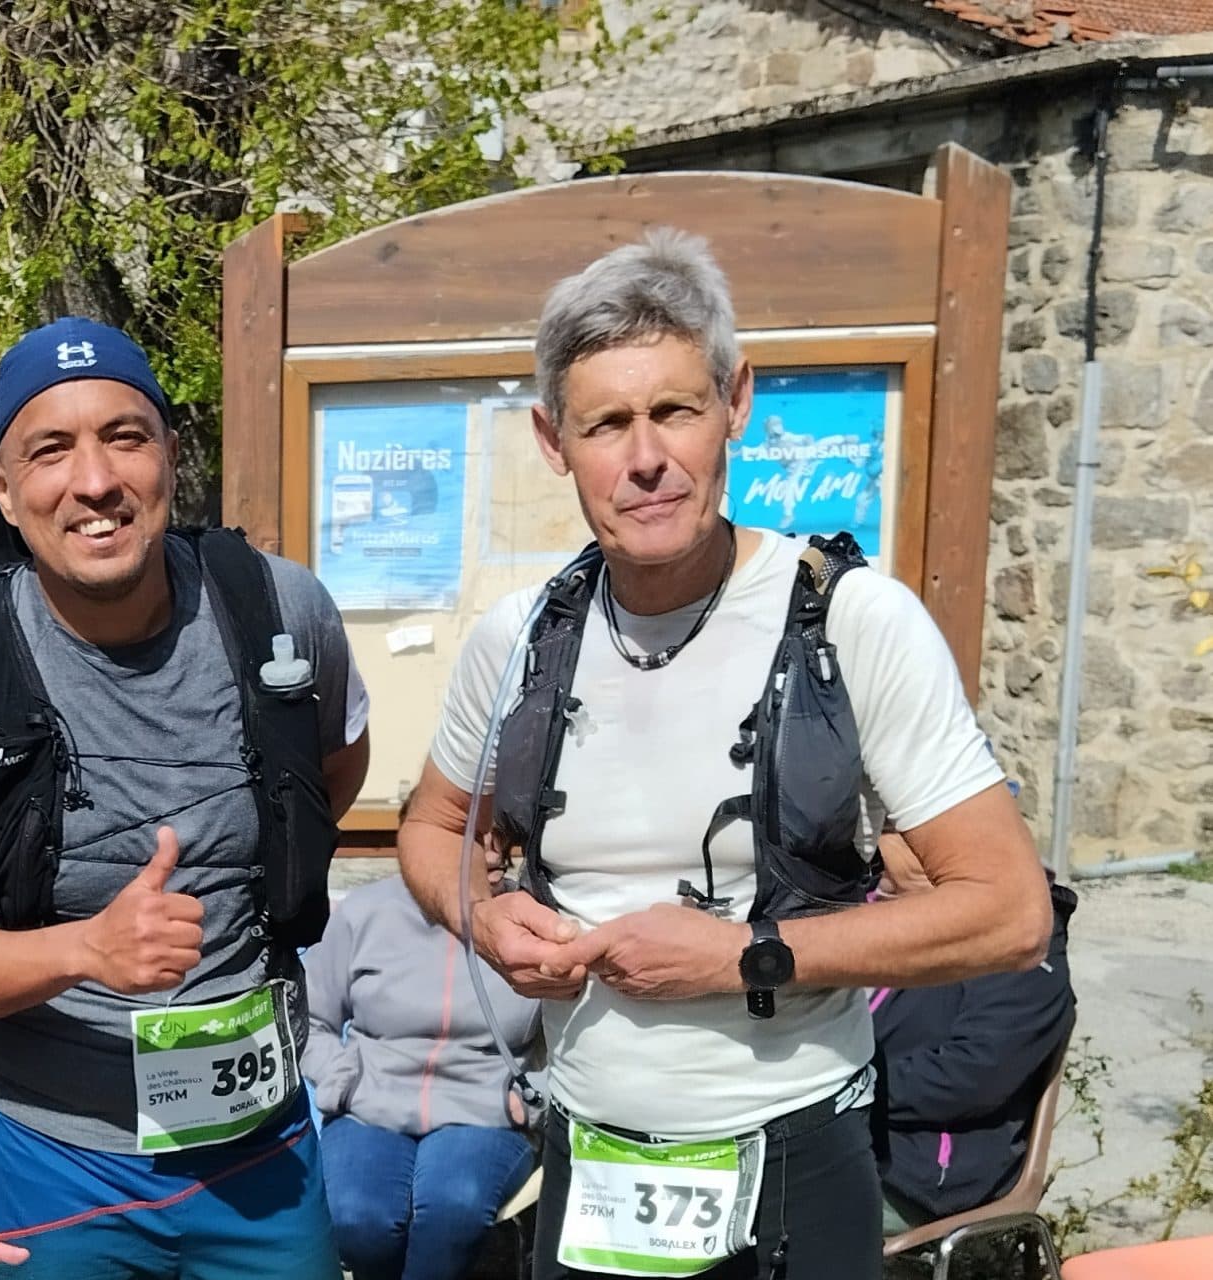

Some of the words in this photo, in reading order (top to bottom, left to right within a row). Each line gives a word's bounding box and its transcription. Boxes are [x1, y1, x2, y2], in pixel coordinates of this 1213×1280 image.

[338, 440, 451, 471] Nozières
[742, 443, 871, 462] L'ADVERSAIRE
[744, 473, 811, 507] MON
[810, 471, 863, 505] AMI
[228, 1001, 268, 1030] RAIDLIGHT
[211, 1043, 276, 1097] 395
[149, 1089, 187, 1106] 57KM
[580, 1203, 615, 1219] 57KM
[634, 1182, 723, 1229] 373
[649, 1237, 697, 1251] BORALEX
